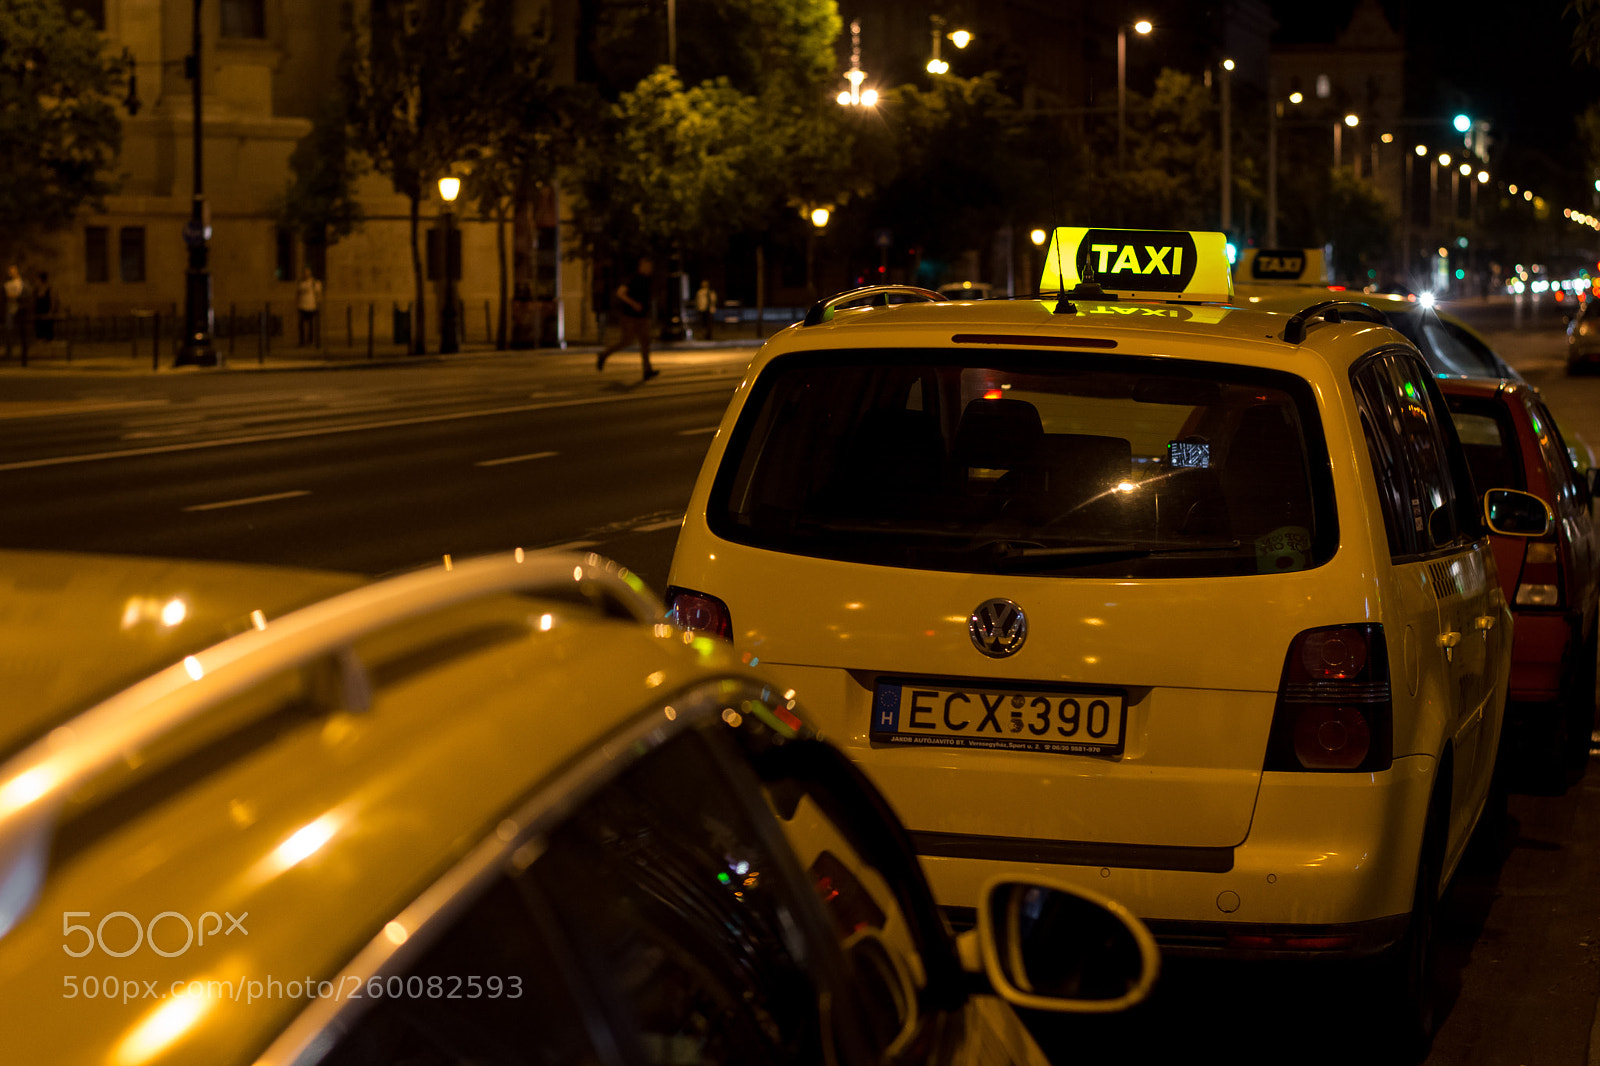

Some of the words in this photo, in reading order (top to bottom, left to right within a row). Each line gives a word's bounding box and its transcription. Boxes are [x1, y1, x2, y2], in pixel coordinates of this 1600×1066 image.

[1091, 243, 1184, 276] TAXI
[1258, 255, 1303, 273] TAXI
[881, 711, 894, 726] H
